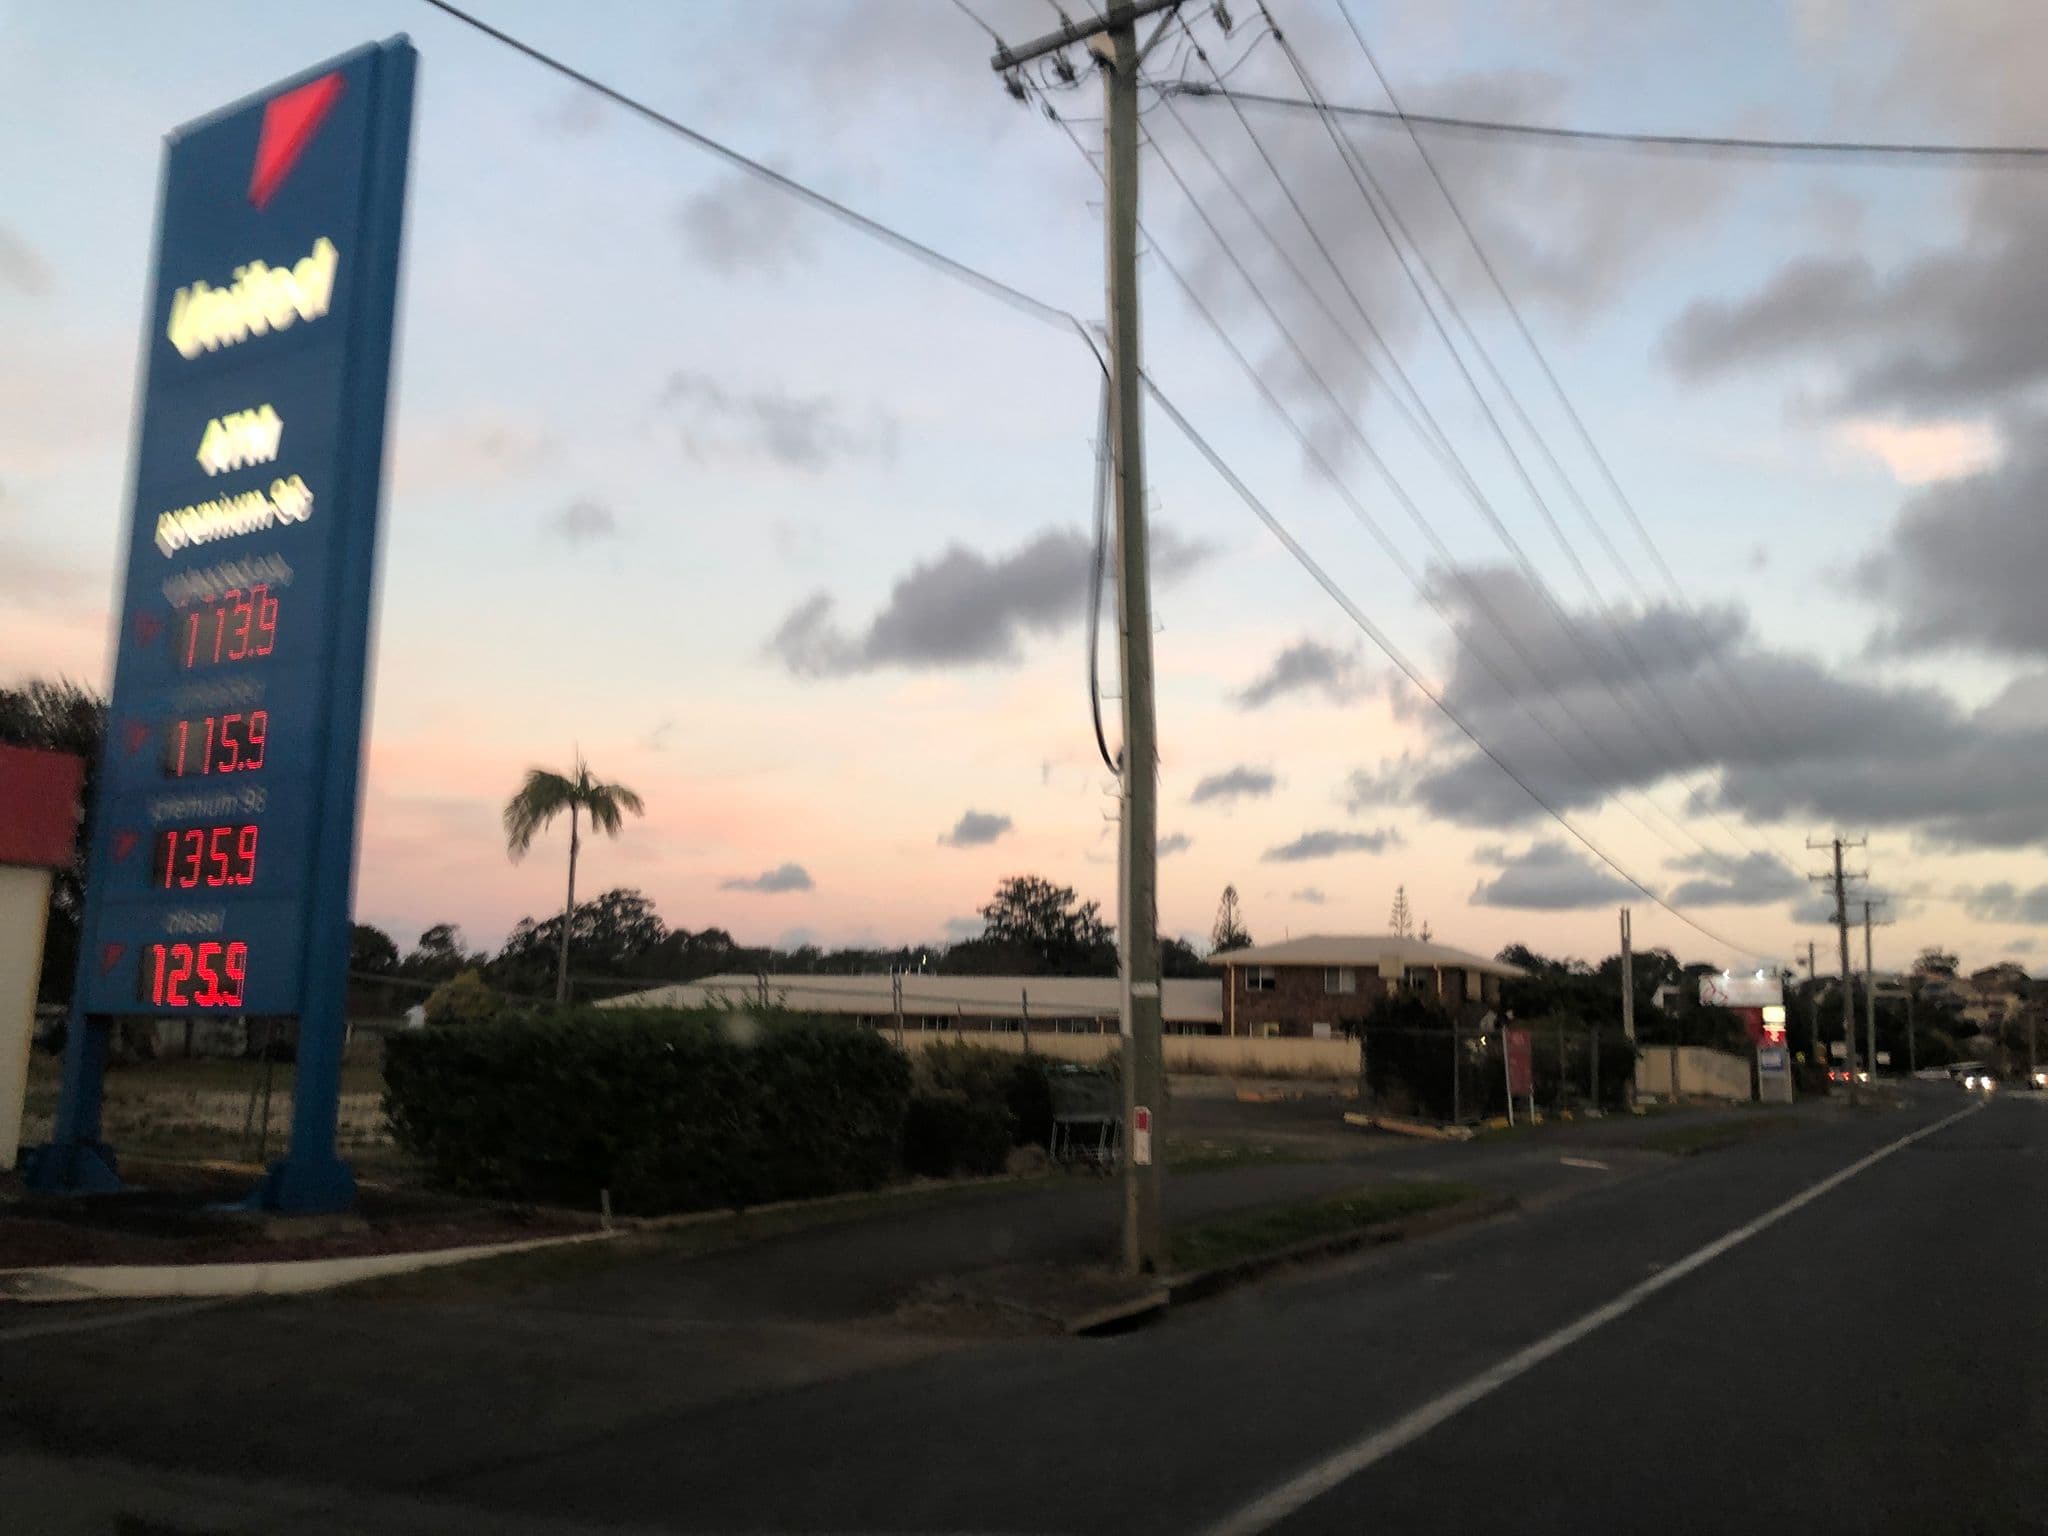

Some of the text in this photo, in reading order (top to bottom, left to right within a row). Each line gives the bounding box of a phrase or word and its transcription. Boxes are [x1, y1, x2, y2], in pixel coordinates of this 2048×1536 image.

[183, 584, 280, 668] 113.9
[176, 711, 270, 778] 115.9
[165, 825, 259, 889] 135.9
[152, 941, 249, 1008] 125.9
